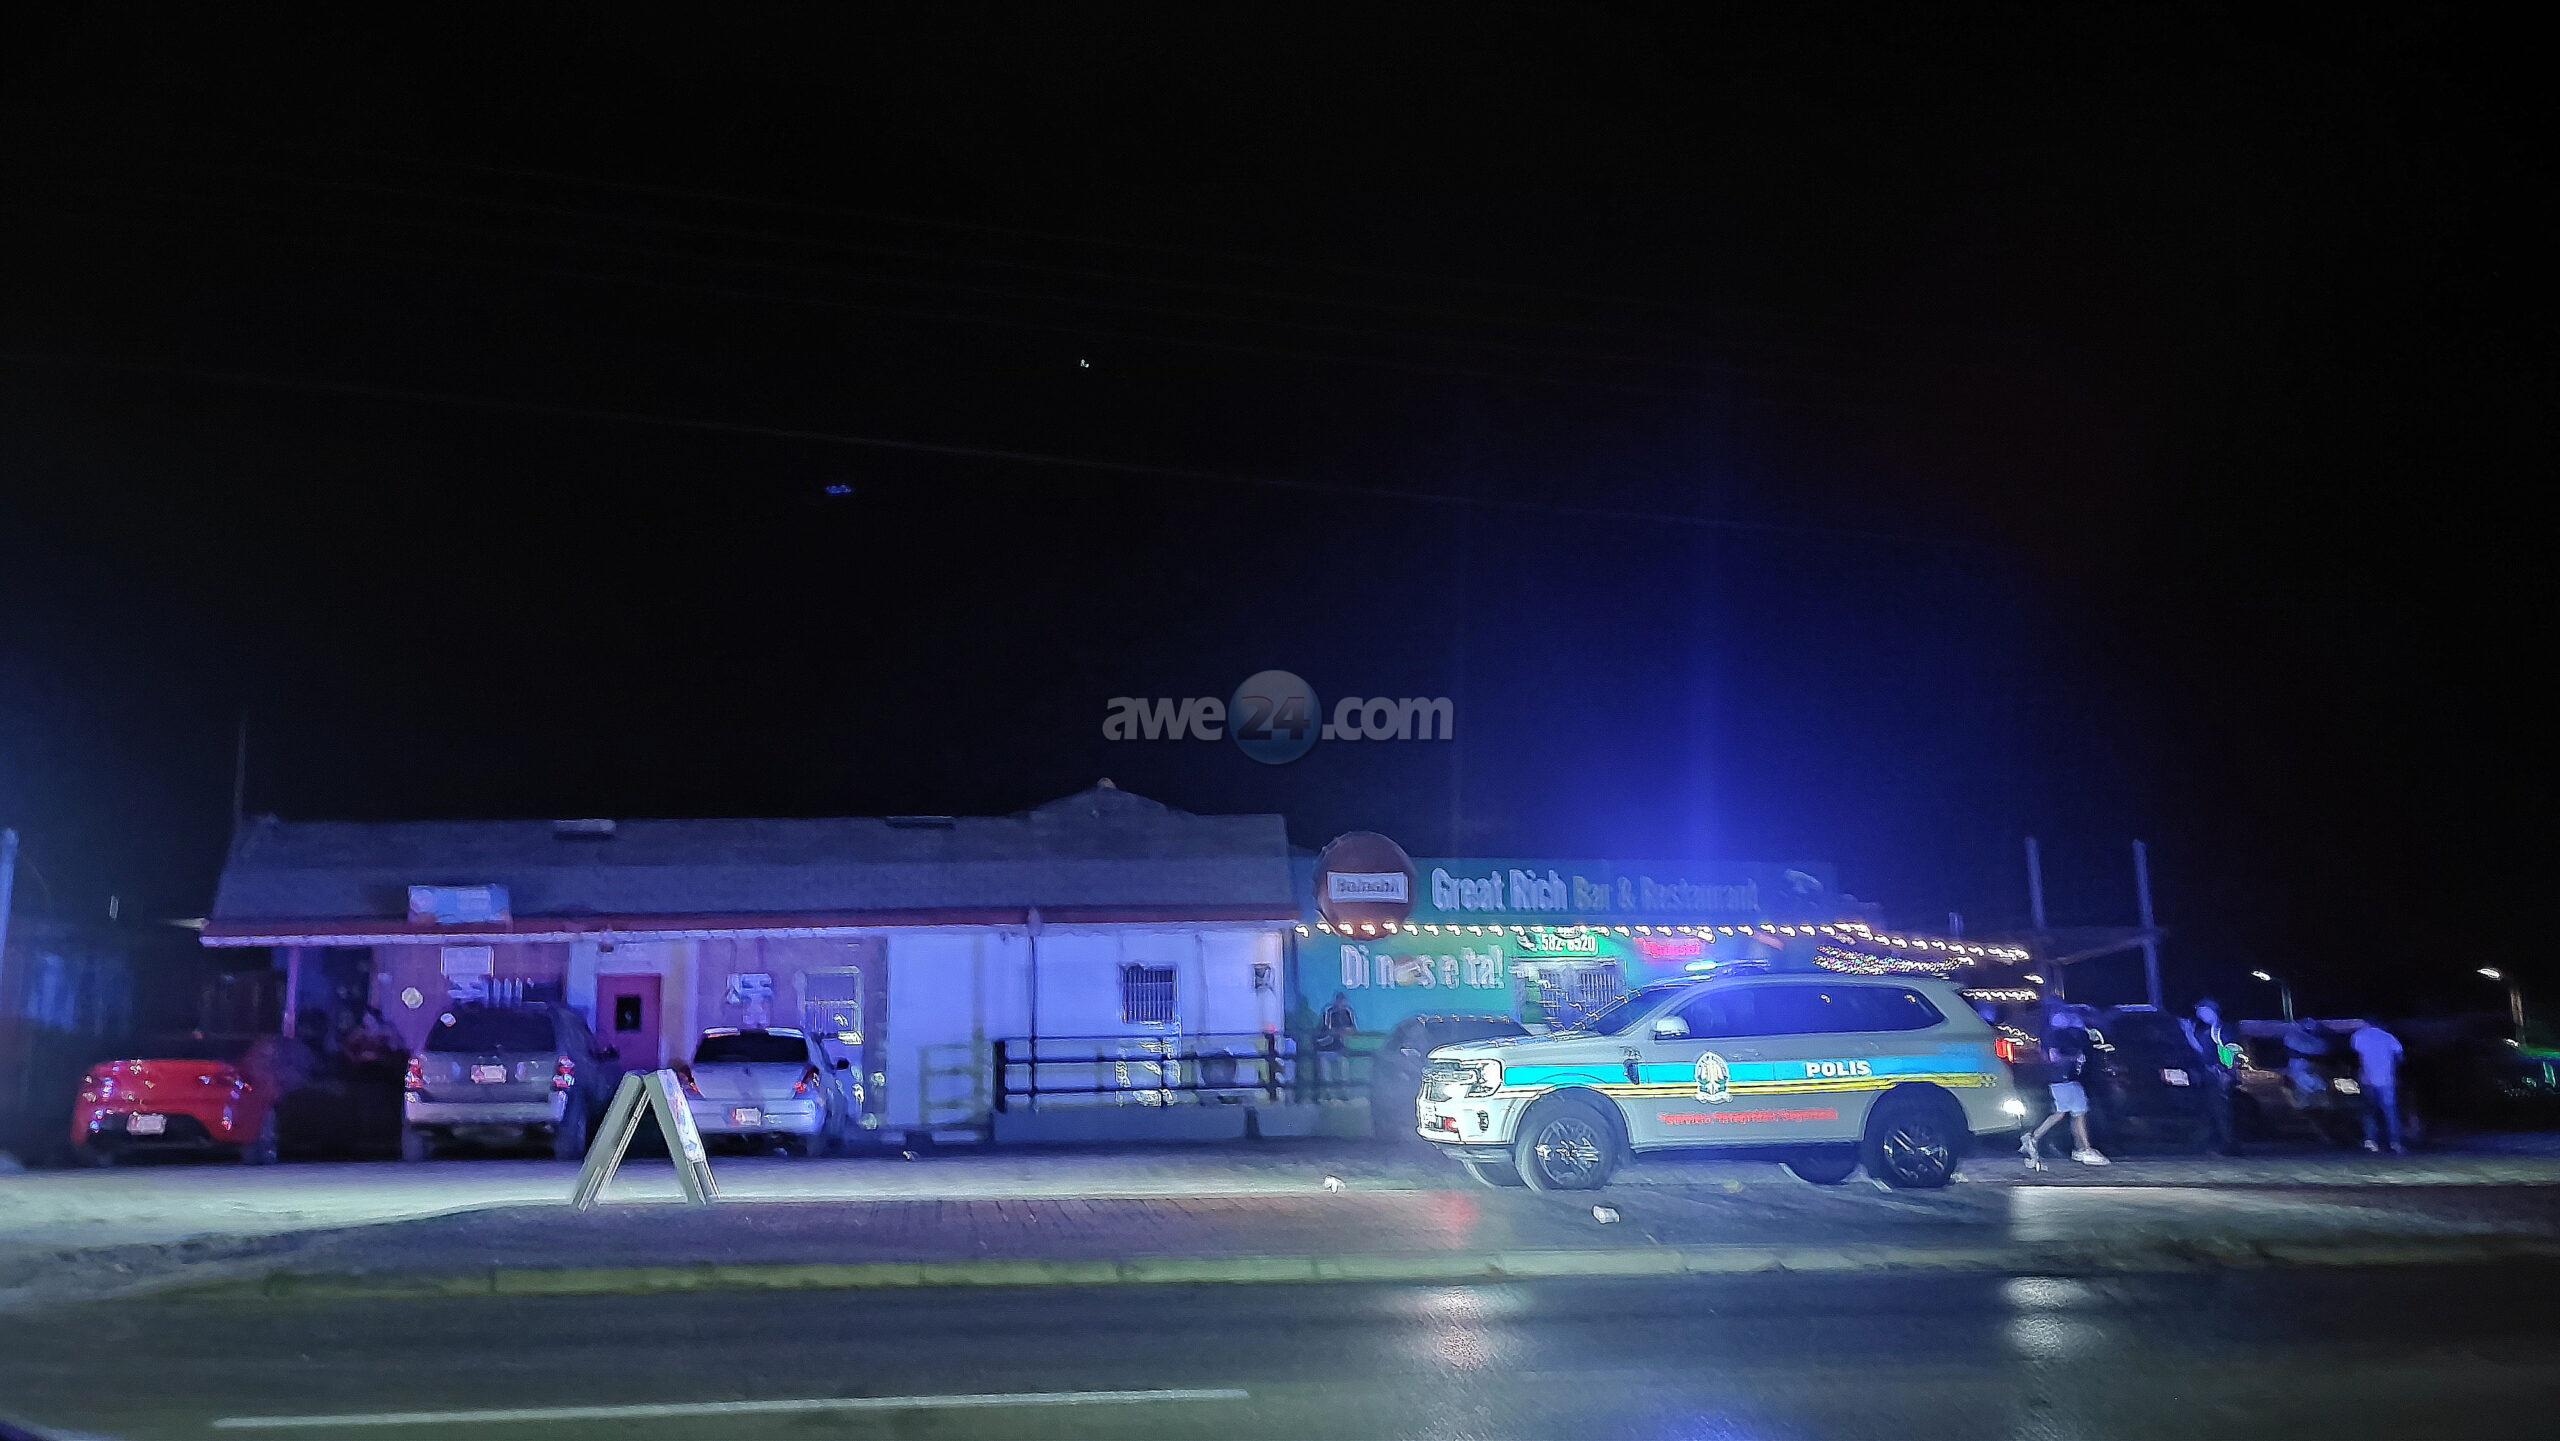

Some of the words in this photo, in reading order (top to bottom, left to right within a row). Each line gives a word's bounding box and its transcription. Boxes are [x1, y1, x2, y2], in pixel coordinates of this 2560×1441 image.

[1431, 867, 1506, 912] Great
[1508, 868, 1568, 912] Rich
[1572, 875, 1611, 911] Bar
[1340, 944, 1370, 990] Di
[1806, 1060, 1873, 1078] POLIS
